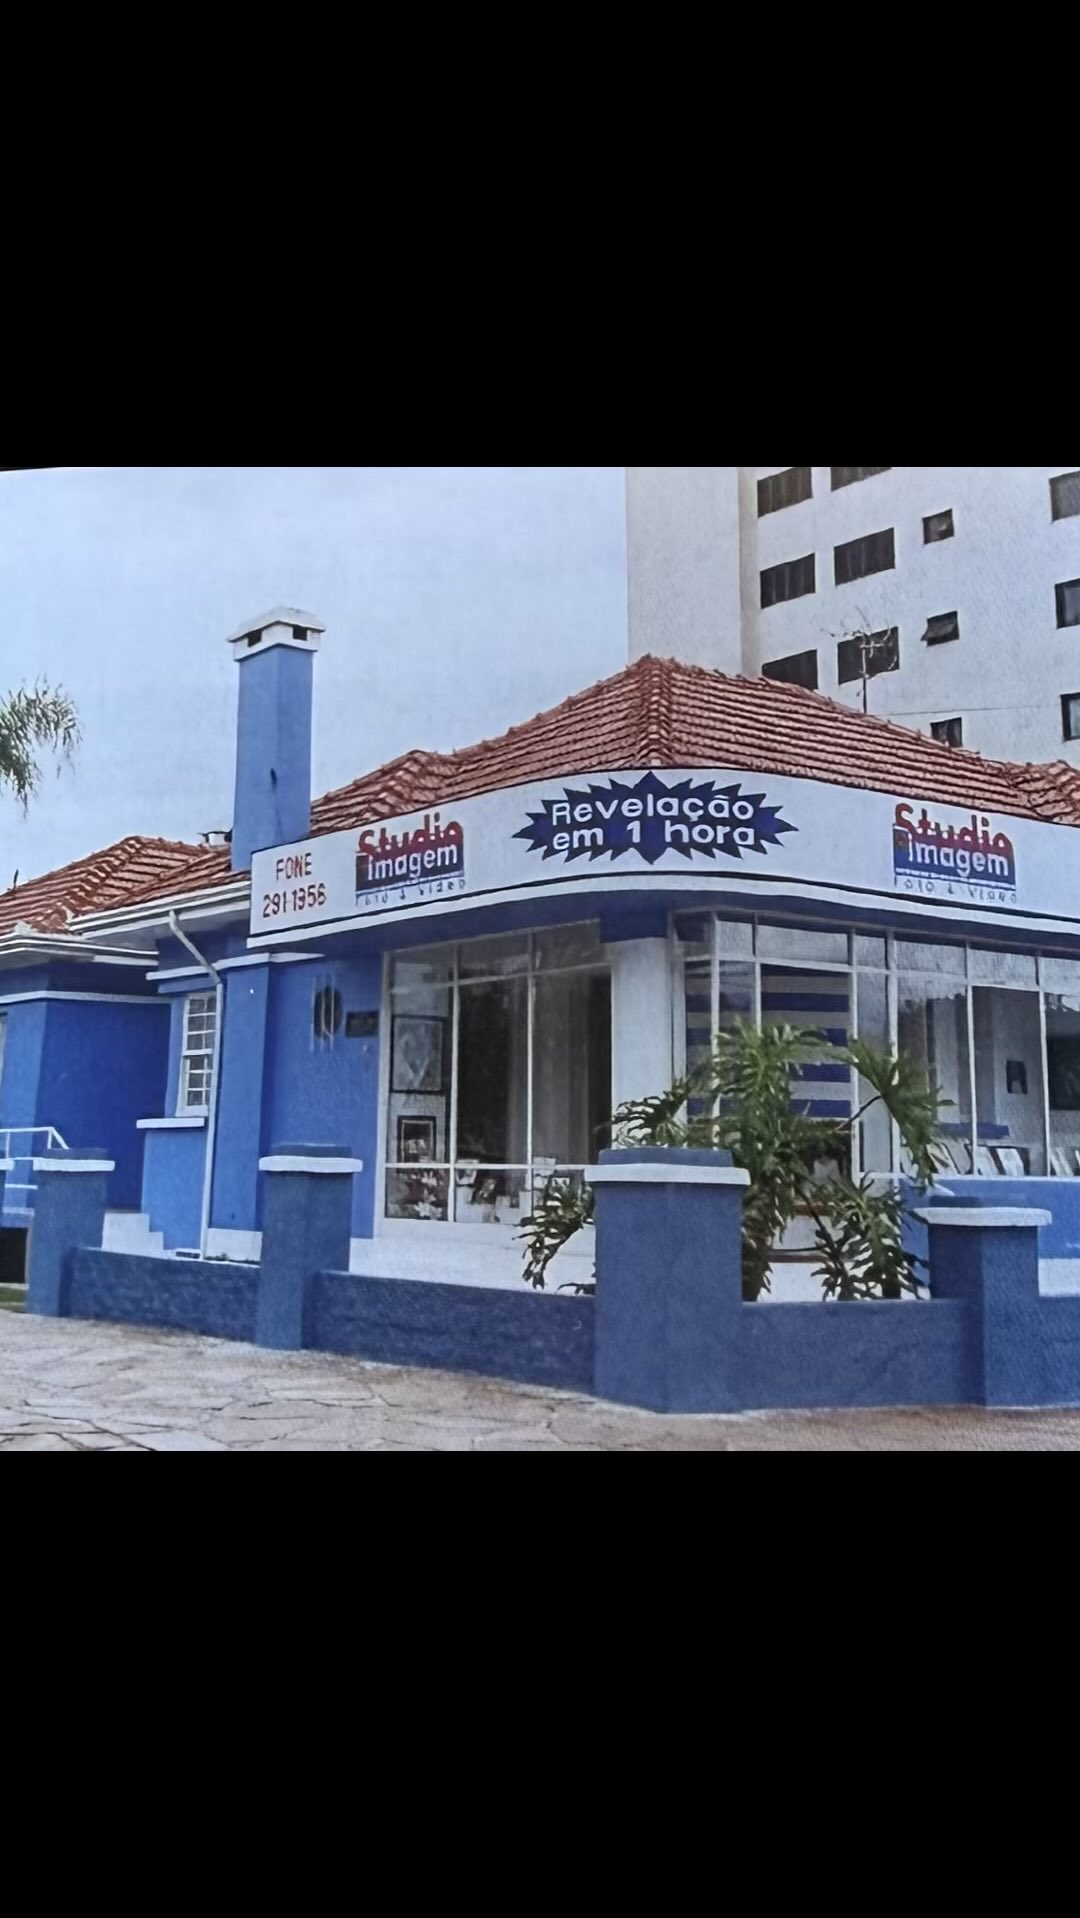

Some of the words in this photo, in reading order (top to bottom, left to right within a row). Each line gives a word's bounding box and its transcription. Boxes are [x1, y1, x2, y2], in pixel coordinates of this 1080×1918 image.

[551, 793, 755, 826] Revelação
[359, 812, 464, 857] Studio
[552, 828, 604, 851] em
[626, 821, 641, 843] 1
[664, 820, 756, 846] hora
[895, 803, 1013, 851] Studio
[275, 852, 313, 881] FONE
